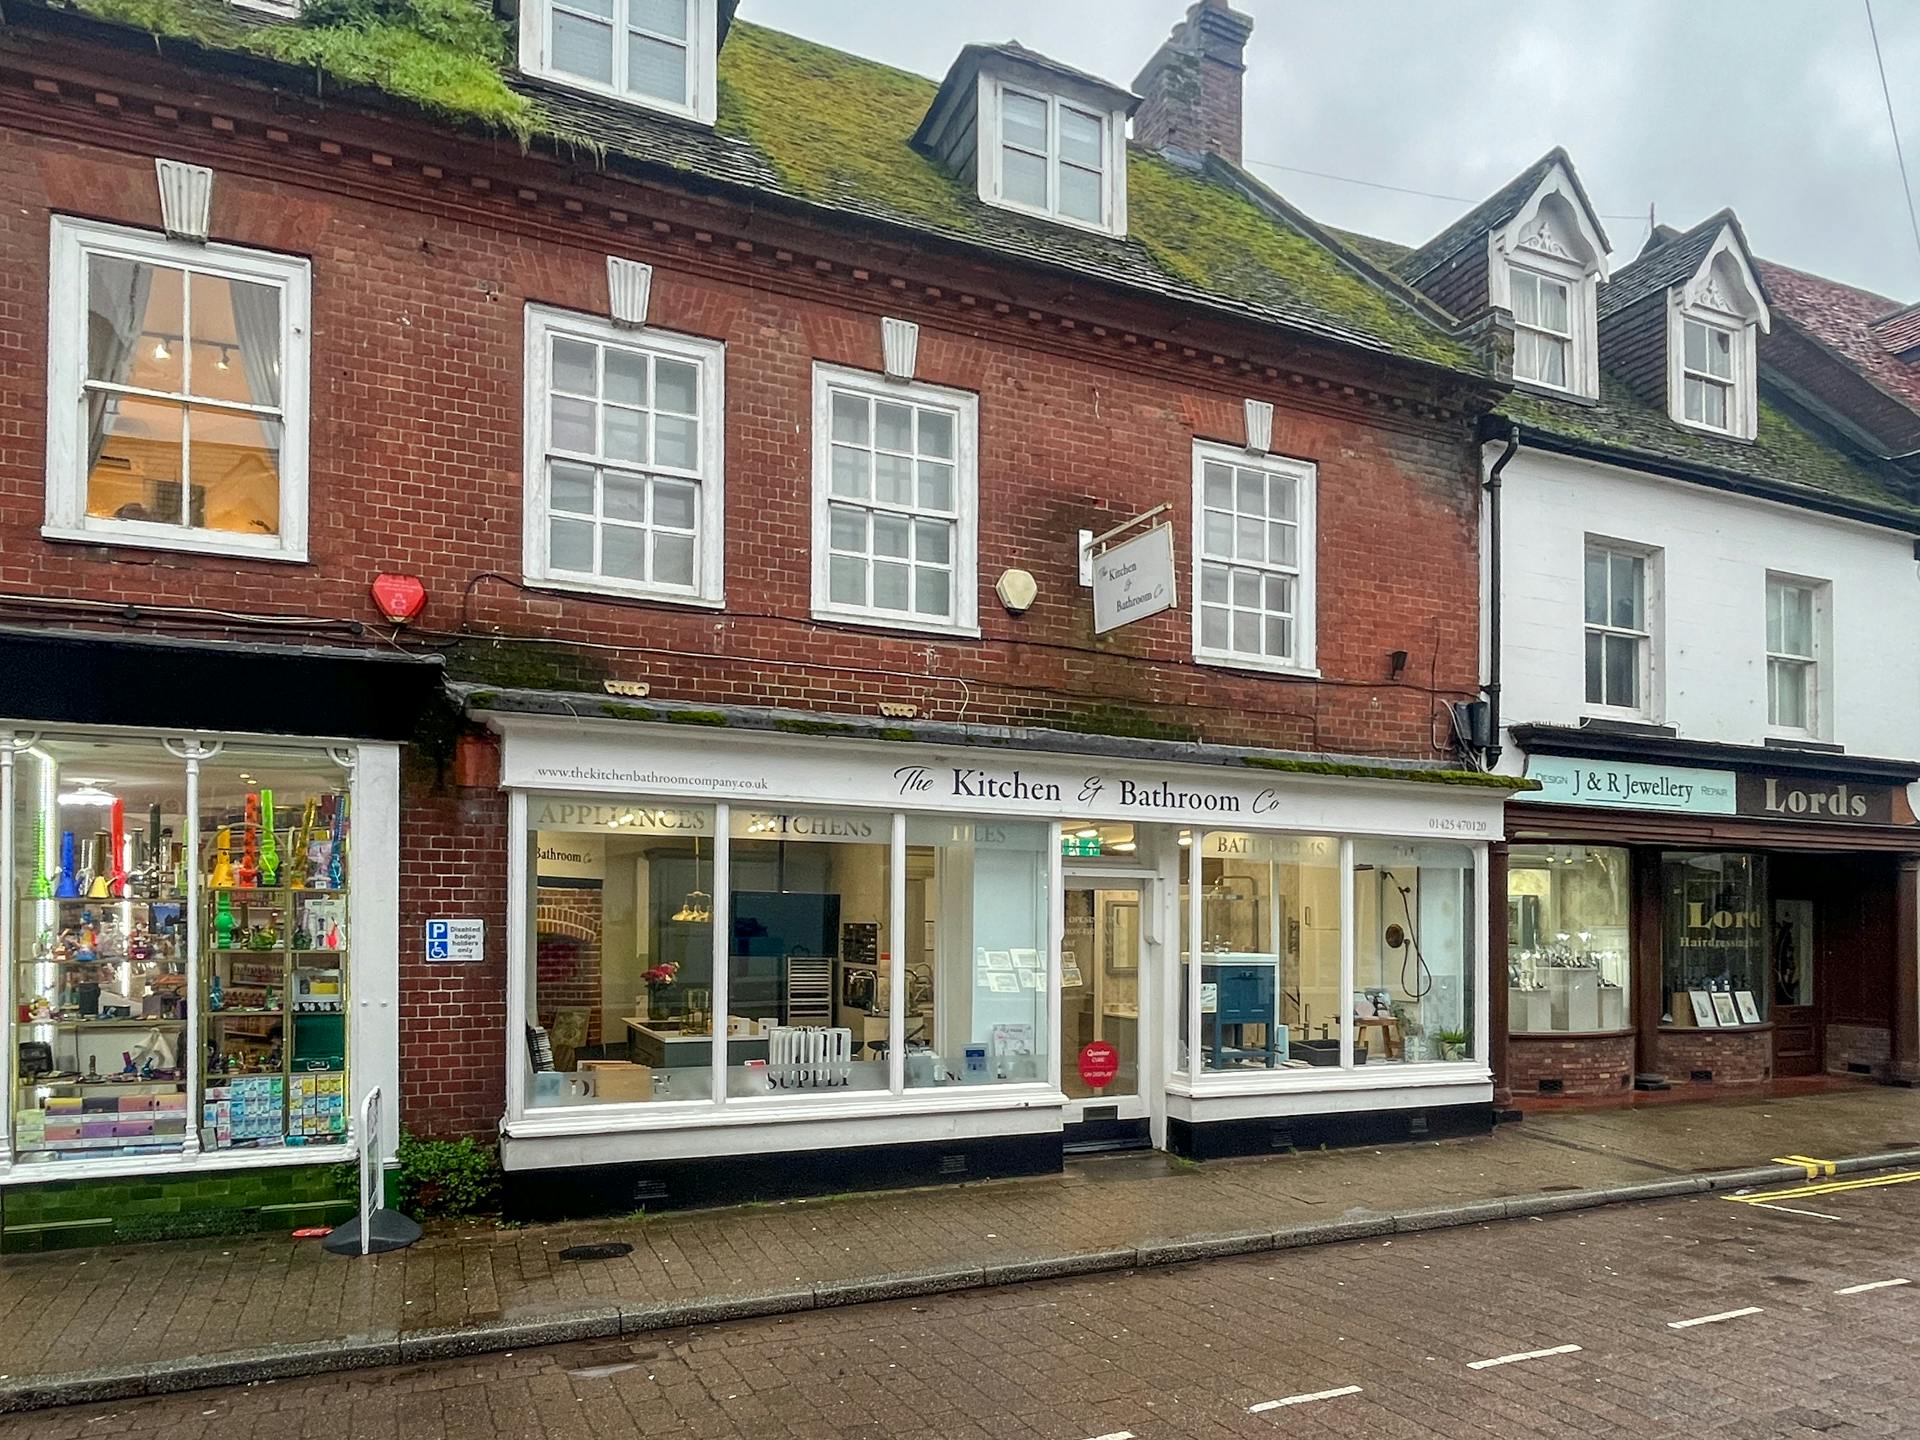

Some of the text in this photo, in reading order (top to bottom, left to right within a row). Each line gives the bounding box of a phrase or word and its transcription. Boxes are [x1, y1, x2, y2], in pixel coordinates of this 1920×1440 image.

[1109, 562, 1137, 581] Kitchen
[1117, 592, 1152, 612] Bathroom
[537, 766, 768, 790] www.thekitchenbathroomcompany.co.uk
[893, 765, 1280, 813] The Kitchen & Bathroom Co
[1535, 772, 1568, 785] DESIGN
[1572, 770, 1693, 803] J & R Jewellery
[1764, 778, 1867, 817] Lords
[1428, 818, 1487, 832] 01425 470120
[766, 1068, 851, 1091] SUPPLY
